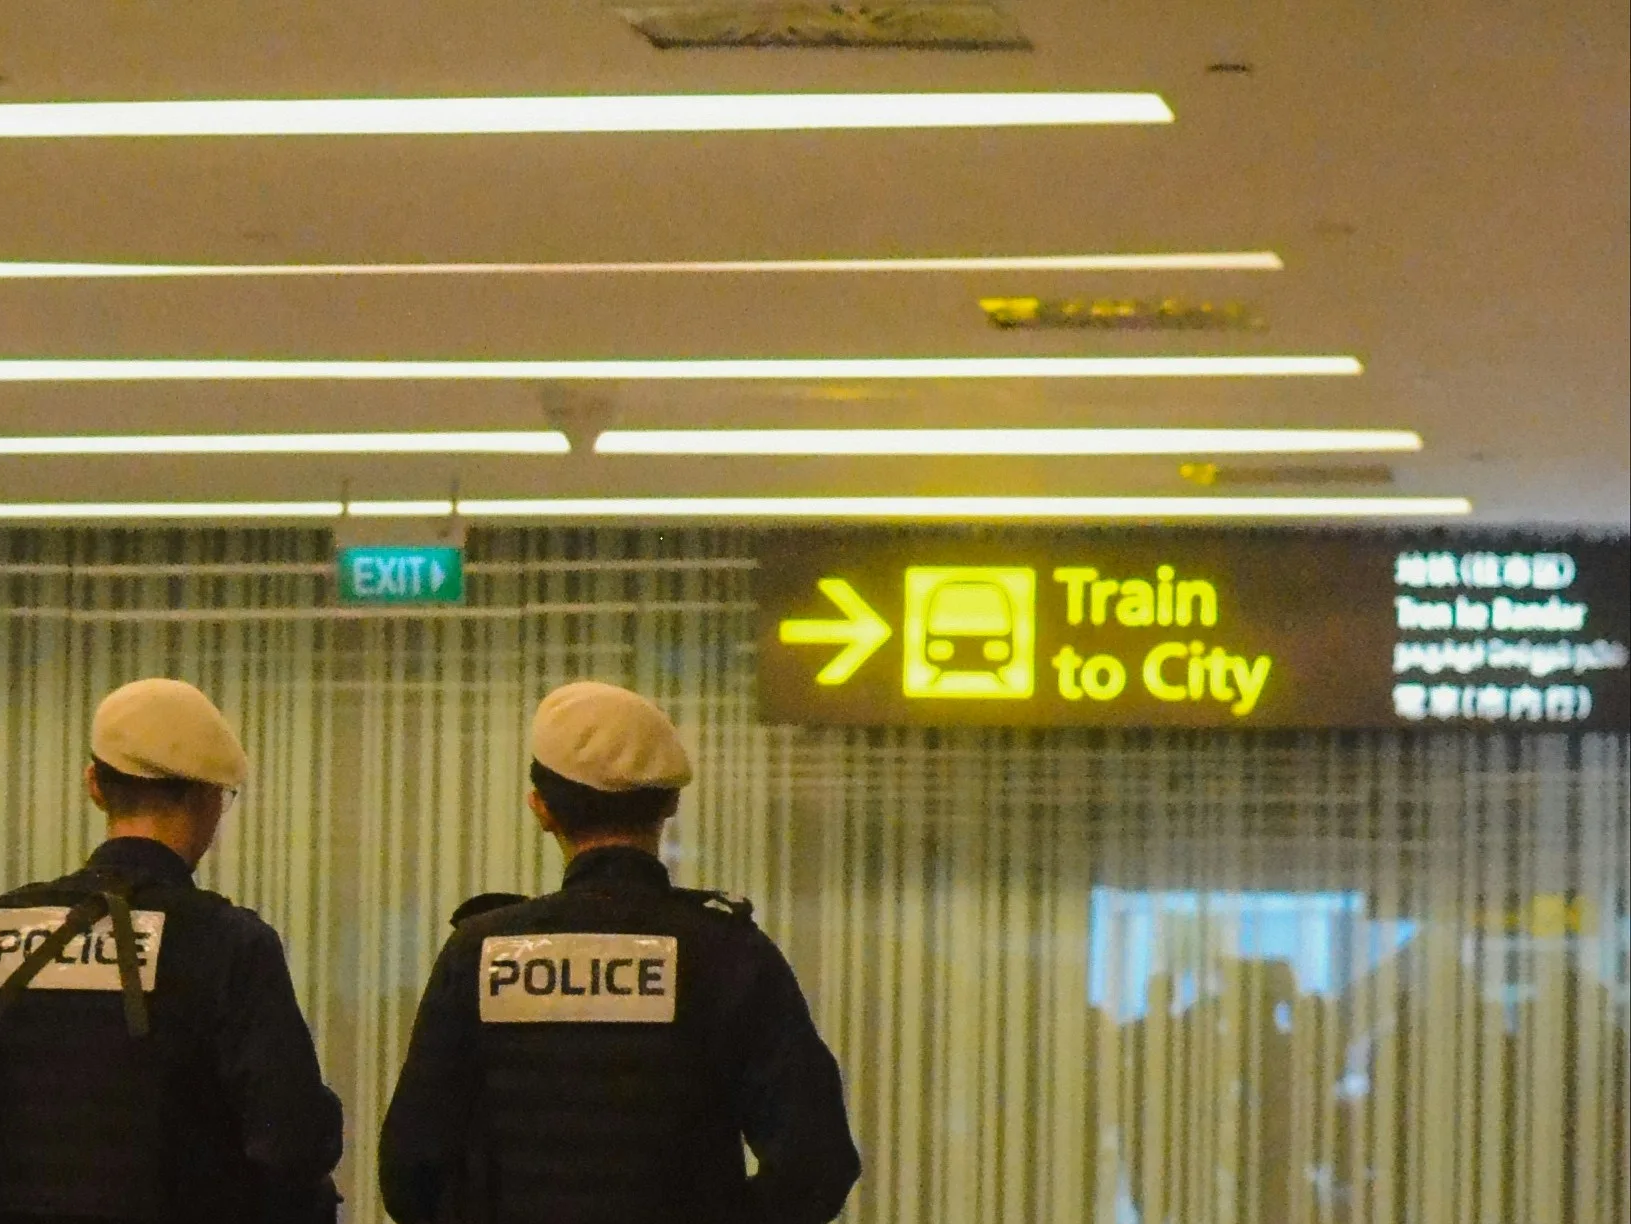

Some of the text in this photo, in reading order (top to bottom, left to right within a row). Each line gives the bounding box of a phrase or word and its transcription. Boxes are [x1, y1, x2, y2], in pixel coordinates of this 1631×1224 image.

[352, 555, 426, 597] EXIT
[1052, 564, 1218, 628] Train
[1051, 639, 1273, 717] to City
[489, 958, 666, 997] POLICE
